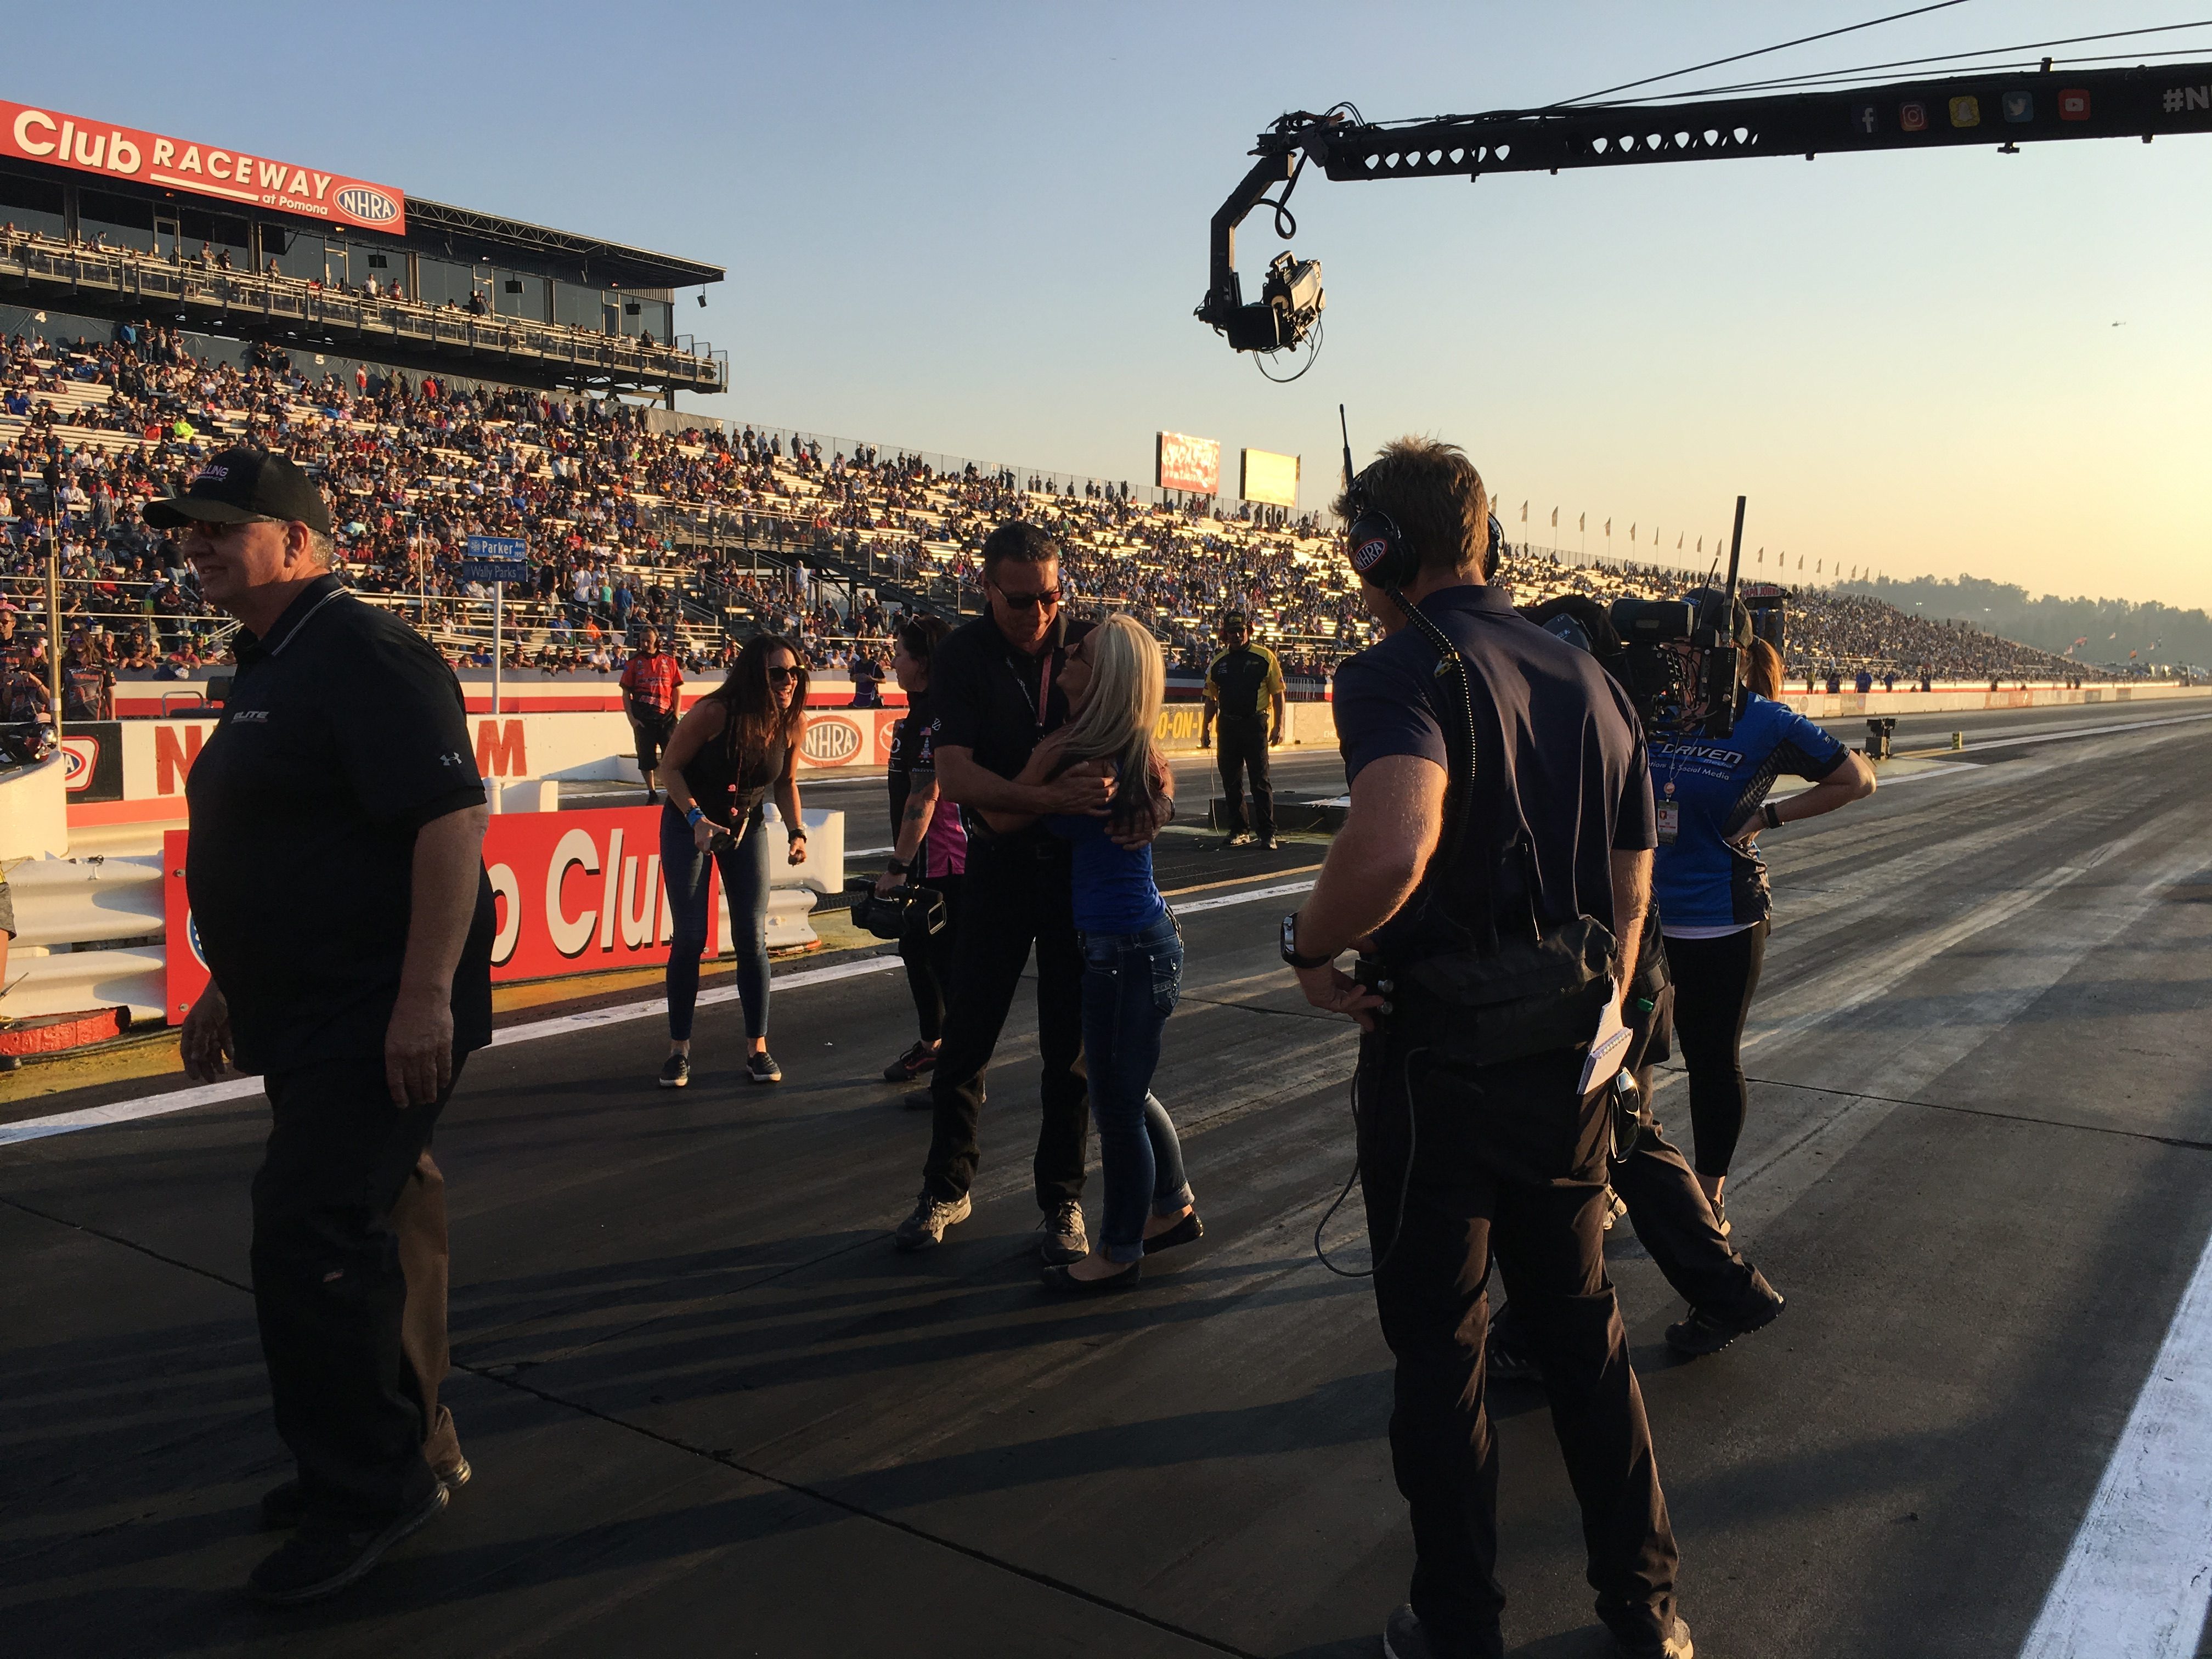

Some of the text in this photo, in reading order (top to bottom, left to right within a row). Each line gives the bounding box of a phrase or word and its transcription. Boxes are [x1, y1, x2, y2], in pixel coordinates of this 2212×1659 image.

[2163, 85, 2212, 112] #N
[14, 110, 332, 200] Club RACEWAY
[263, 194, 328, 216] at Pomona
[344, 191, 392, 219] NHRA
[35, 312, 47, 323] 4
[315, 354, 325, 365] 5
[482, 540, 513, 555] Parker
[1356, 543, 1383, 568] NHRA
[470, 566, 493, 581] Wally
[494, 566, 516, 578] Parks
[805, 725, 853, 757] NHRA
[1661, 743, 1743, 764] DRIVEN
[1678, 764, 1701, 773] Social
[1702, 768, 1730, 781] Media
